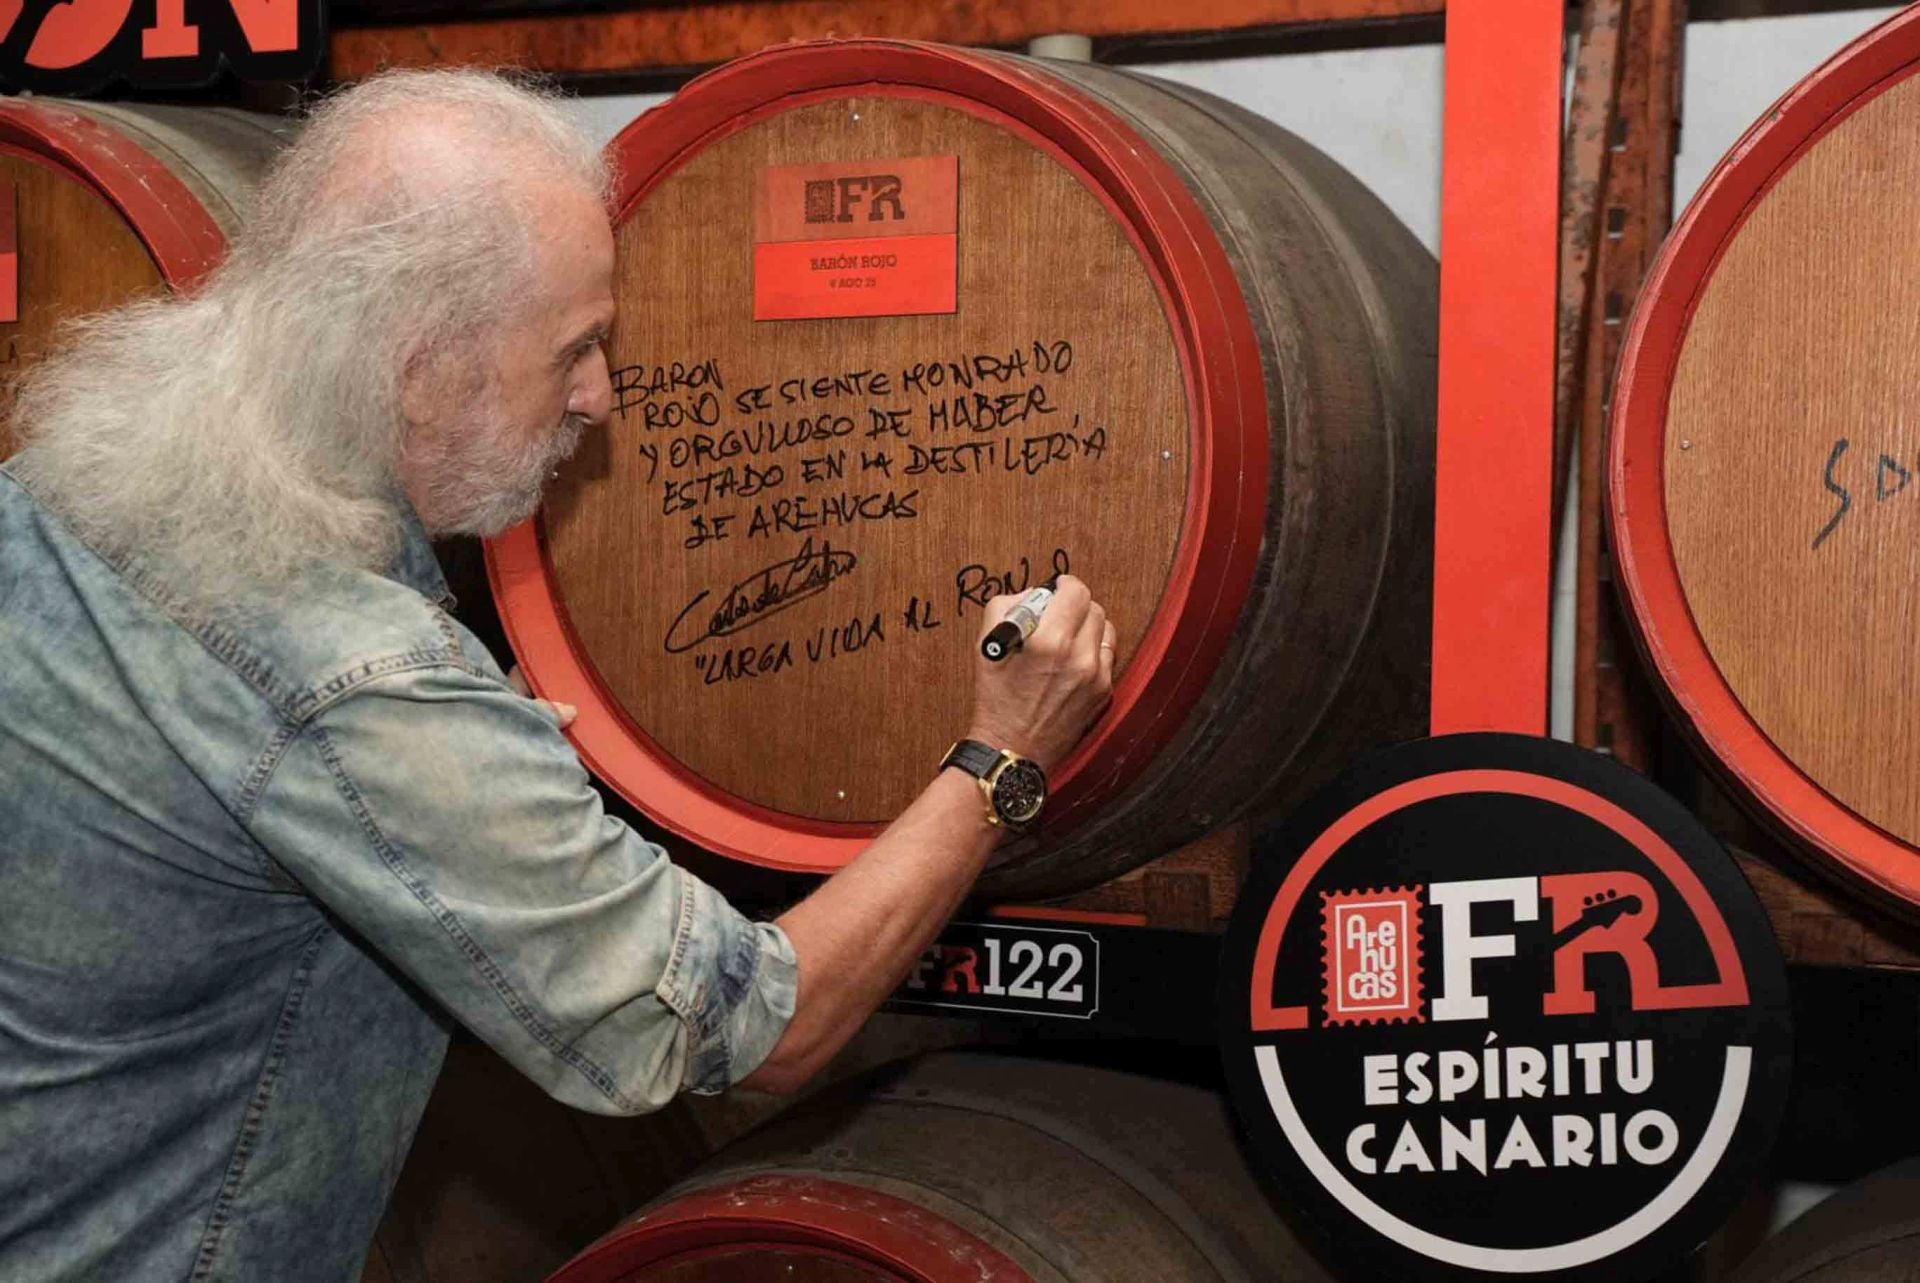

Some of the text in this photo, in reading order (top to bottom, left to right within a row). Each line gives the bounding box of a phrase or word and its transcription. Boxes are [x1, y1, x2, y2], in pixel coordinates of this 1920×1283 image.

[810, 253, 898, 271] BARÓN ROJO
[865, 408, 912, 440] DE
[930, 384, 1058, 432] HABER
[663, 464, 784, 515] ESTADO
[801, 450, 846, 483] EN
[861, 451, 893, 478] LA
[807, 615, 884, 662] VIDA
[904, 597, 941, 632] AL
[1363, 1031, 1654, 1106] ESPÍRITU
[1345, 1109, 1680, 1177] CANARIO
